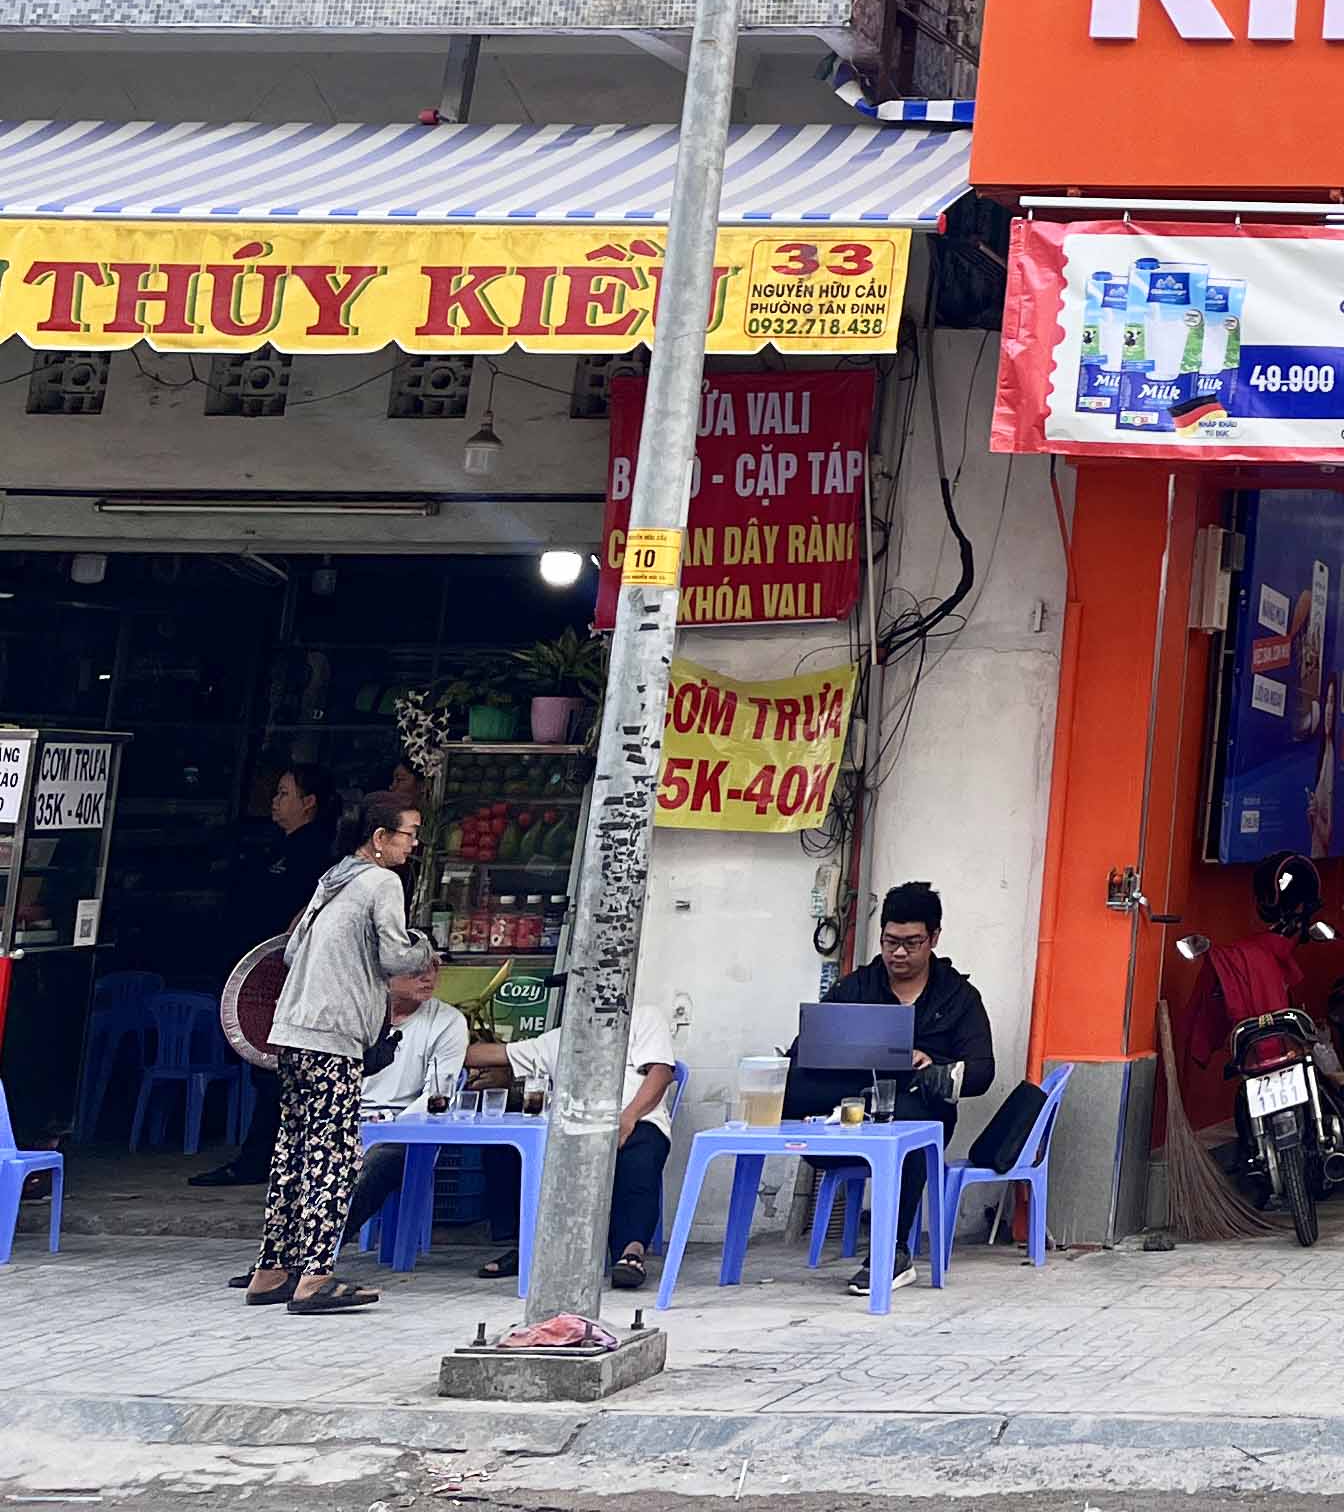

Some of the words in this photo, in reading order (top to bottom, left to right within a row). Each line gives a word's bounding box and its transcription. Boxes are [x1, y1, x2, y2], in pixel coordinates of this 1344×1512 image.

[771, 243, 874, 276] 33
[22, 241, 388, 337] THÚY
[819, 281, 850, 298] HỮU
[750, 299, 813, 315] PHƯỜNG
[819, 300, 846, 315] TÂN
[851, 302, 886, 318] ĐỊNH
[748, 317, 884, 335] 0932.718.438
[1093, 374, 1120, 387] Mil
[1137, 382, 1181, 400] Milk
[696, 379, 736, 437] ỬA
[746, 391, 811, 435] VALI
[735, 443, 798, 506] CẶP
[807, 441, 863, 495] TÁP
[723, 518, 780, 565] DÂY
[634, 549, 656, 568] 10
[762, 582, 822, 618] VALI
[664, 678, 738, 737] ƠM
[748, 681, 844, 742] TRƯA
[656, 757, 836, 817] 5K-40K
[36, 793, 65, 826] 35K
[75, 793, 104, 825] 40K
[499, 981, 542, 1001] Cozy
